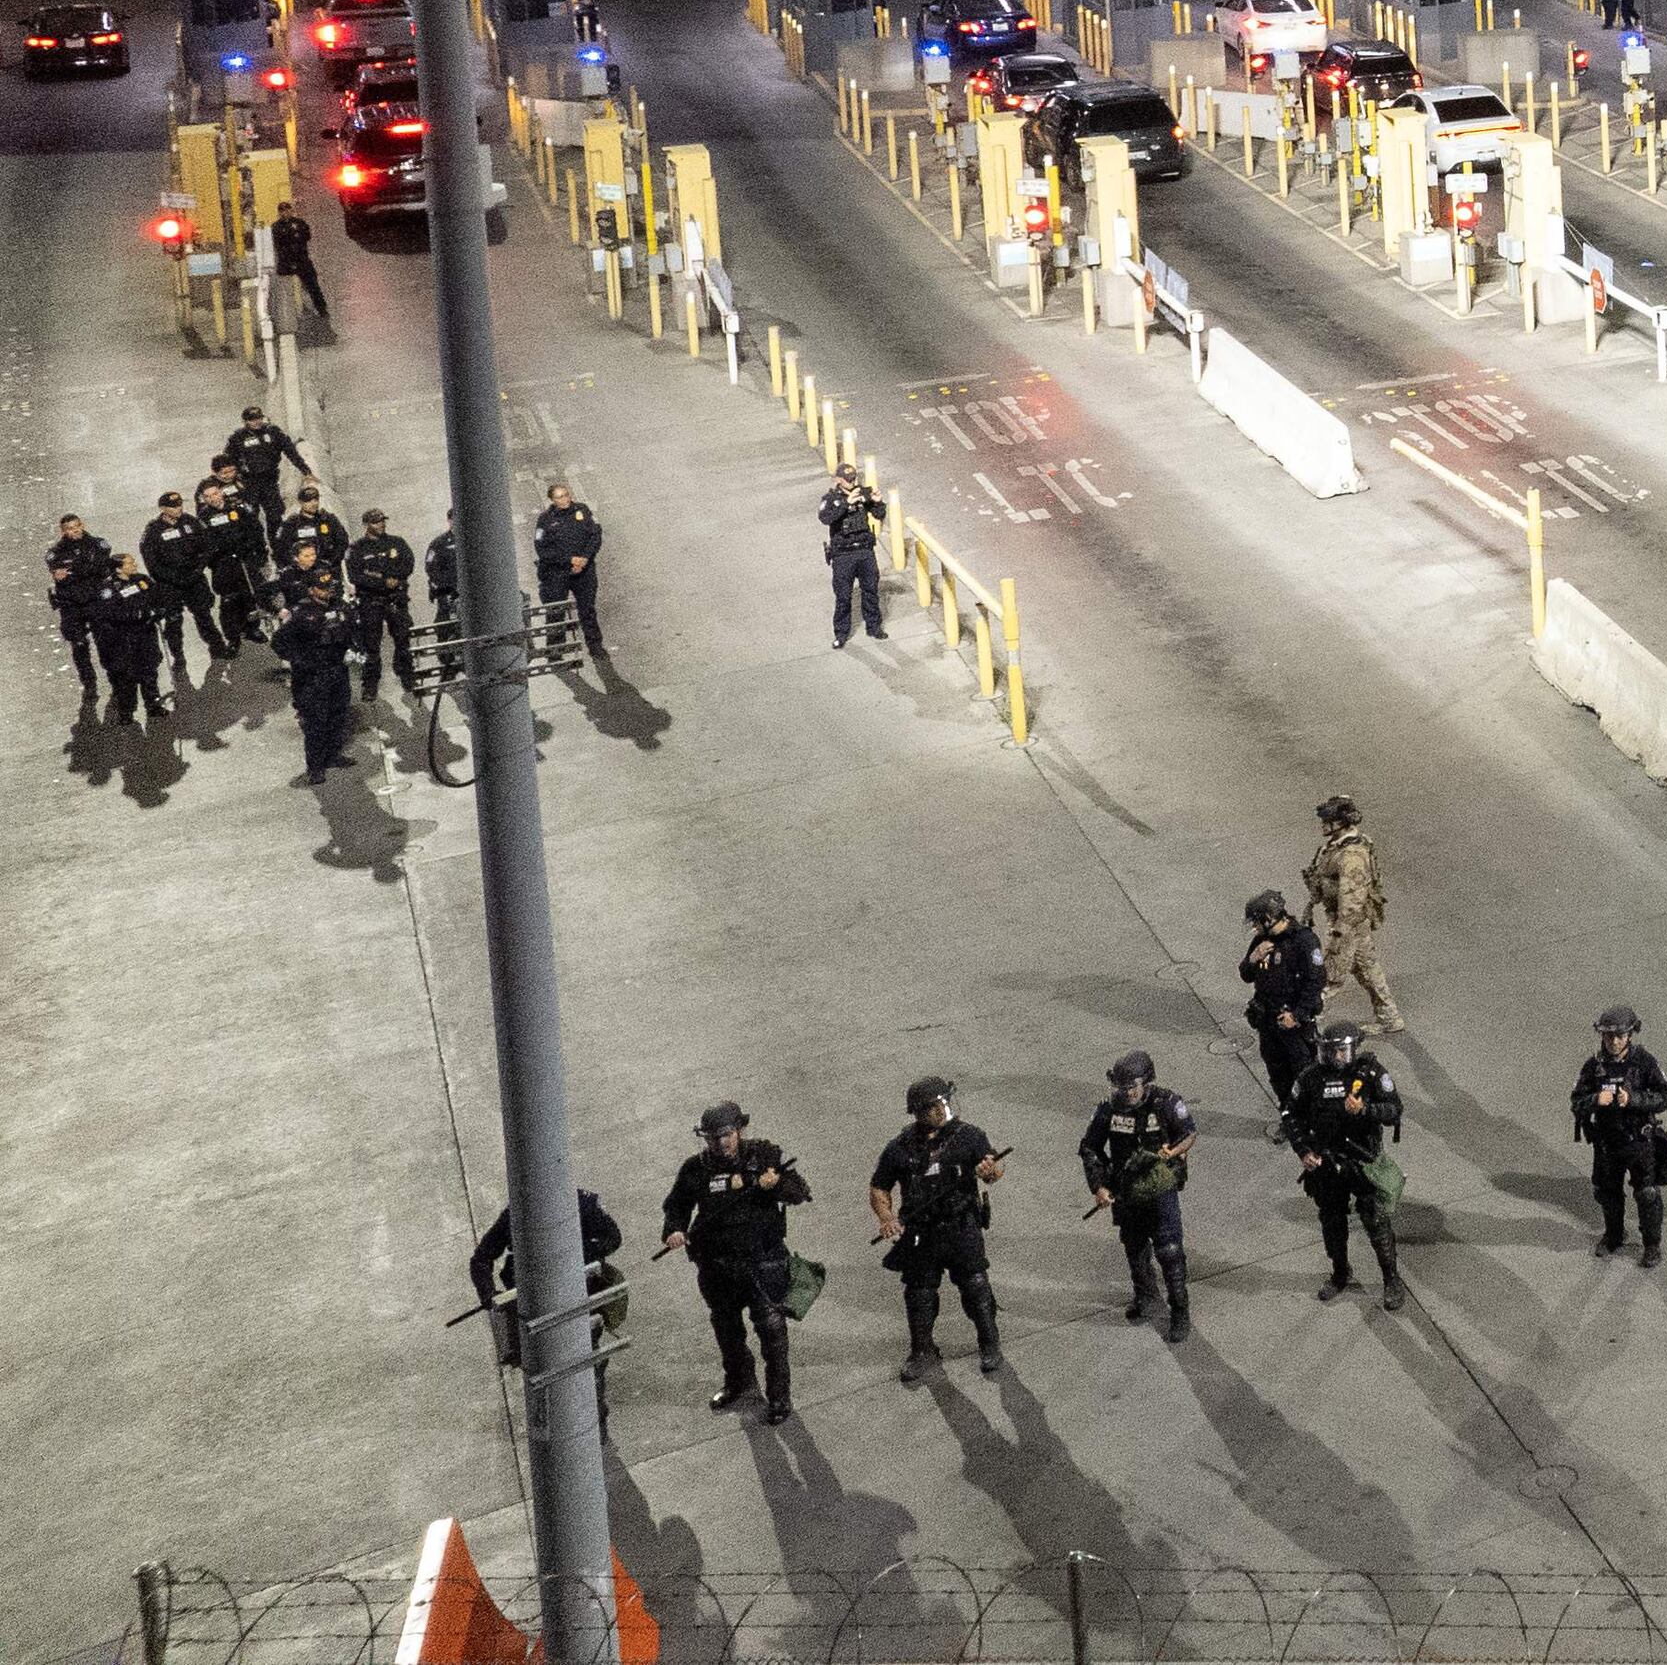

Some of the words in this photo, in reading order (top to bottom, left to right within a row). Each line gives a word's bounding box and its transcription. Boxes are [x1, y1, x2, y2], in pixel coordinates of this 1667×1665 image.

[950, 458, 1134, 523] LTO
[1480, 454, 1651, 519] LTO
[1324, 1086, 1346, 1094] CBP
[1111, 1115, 1136, 1127] POLICE
